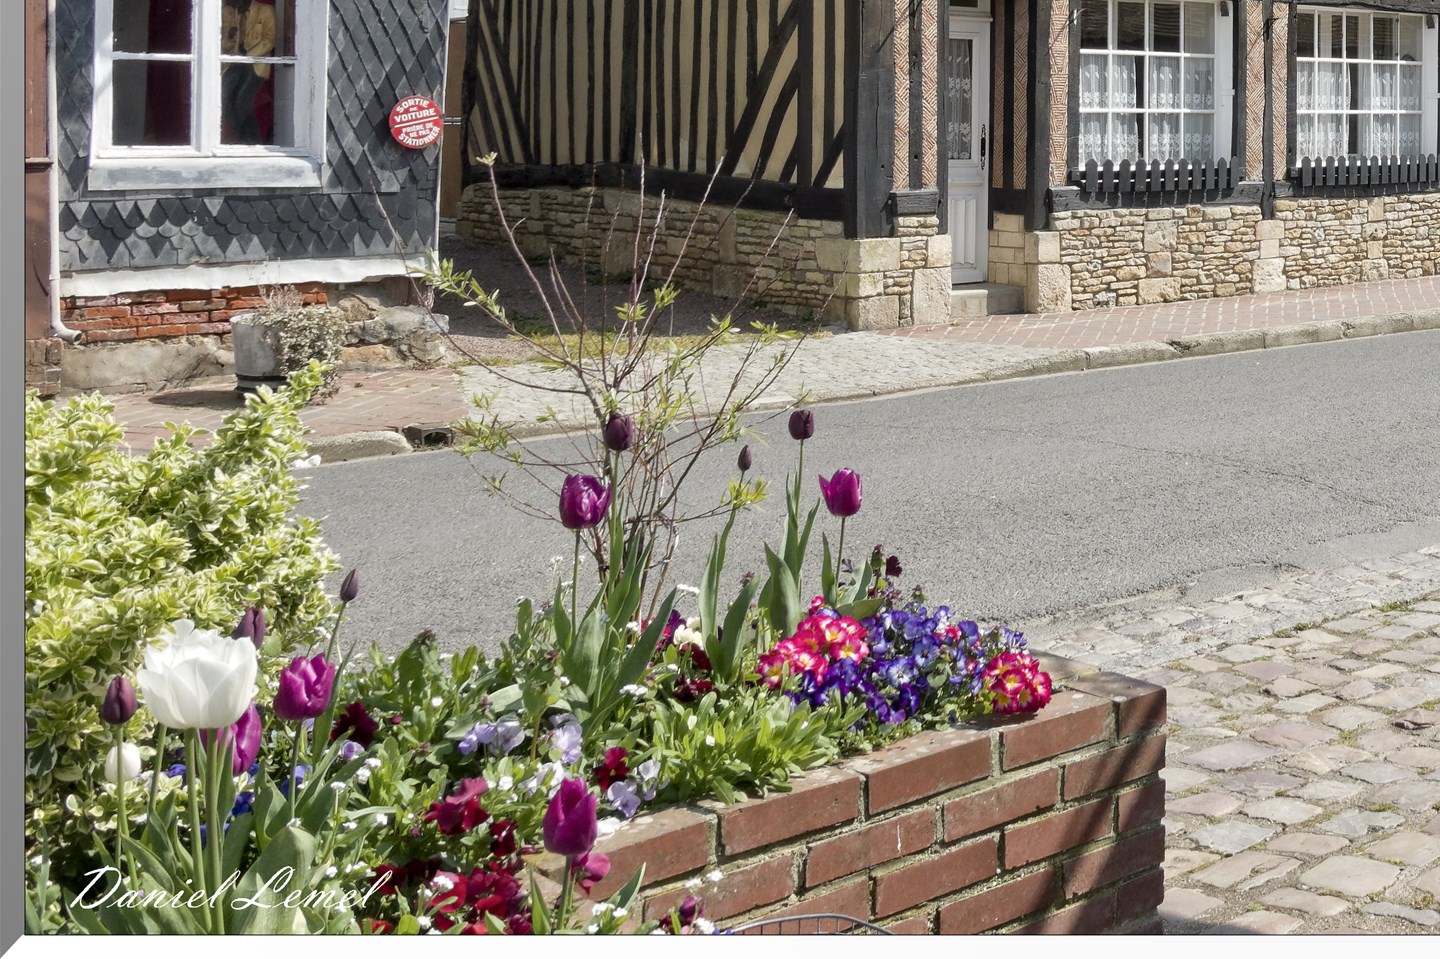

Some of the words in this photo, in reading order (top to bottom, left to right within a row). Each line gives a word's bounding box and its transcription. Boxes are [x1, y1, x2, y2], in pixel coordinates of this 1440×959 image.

[396, 98, 429, 113] SORTIE
[394, 108, 436, 122] VOITURE
[398, 126, 440, 146] STATIONNER
